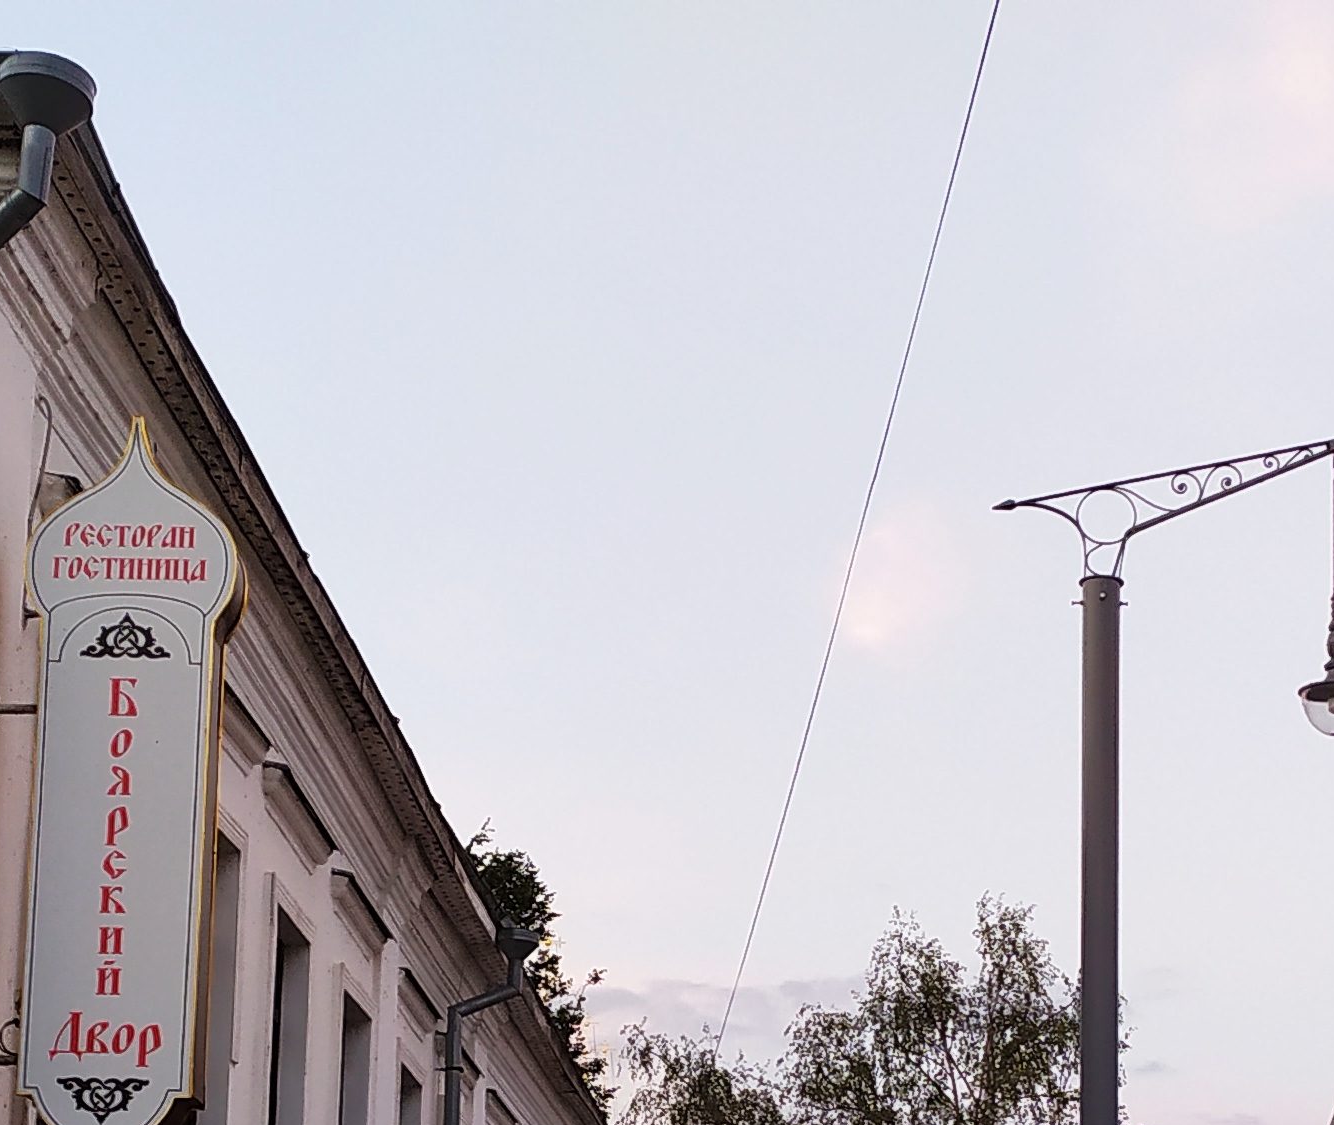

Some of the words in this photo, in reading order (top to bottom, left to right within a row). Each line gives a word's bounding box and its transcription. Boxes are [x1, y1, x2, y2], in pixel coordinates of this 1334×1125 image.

[64, 523, 195, 548] РЕСТОРАН
[52, 556, 207, 584] ГОСТИНИЦА
[49, 1011, 162, 1068] Двор
